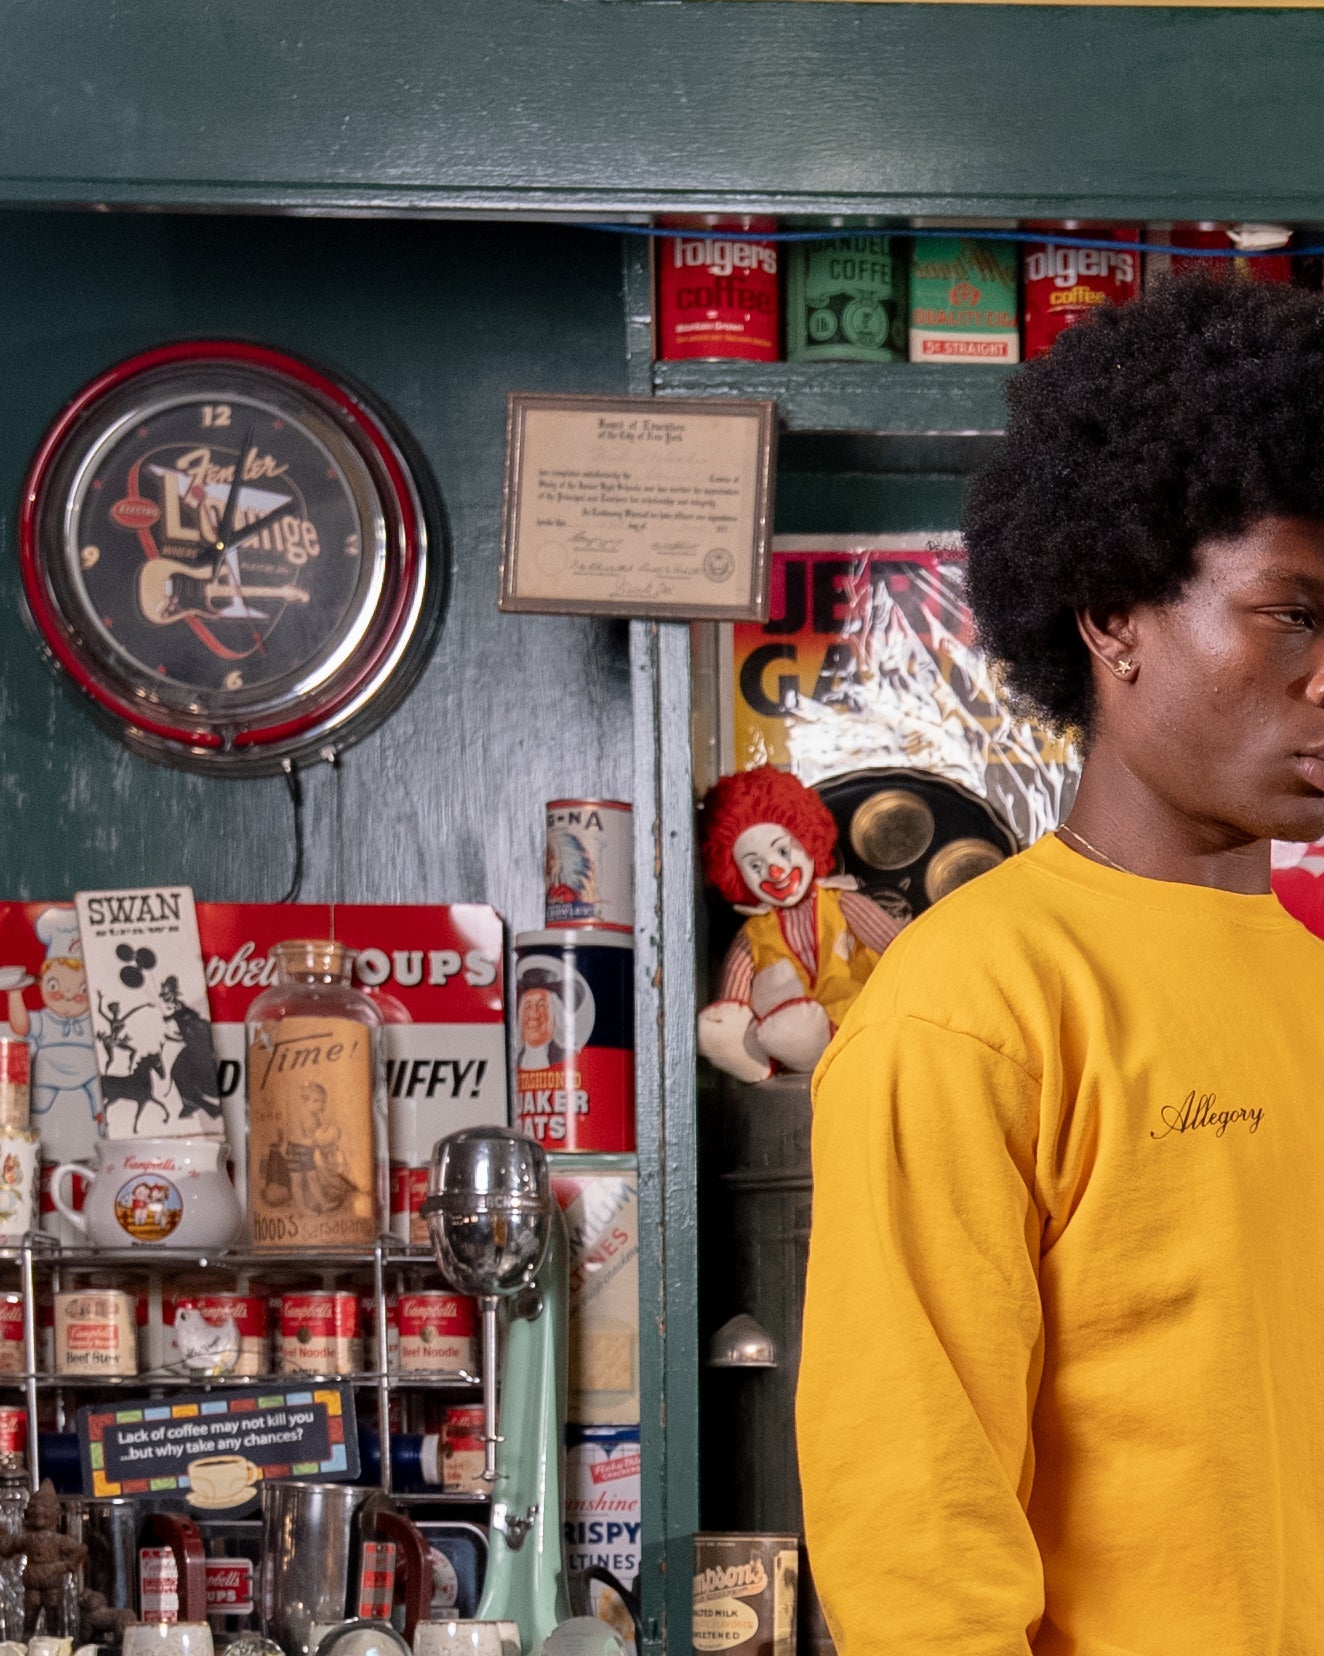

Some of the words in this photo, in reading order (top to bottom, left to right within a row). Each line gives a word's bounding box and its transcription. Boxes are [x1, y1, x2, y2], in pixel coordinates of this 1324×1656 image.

[1026, 245, 1134, 287] olgers
[913, 308, 982, 327] QUALITY
[202, 405, 232, 427] 12
[80, 545, 101, 570] 9
[224, 670, 243, 692] 6
[89, 892, 183, 927] SWAN
[355, 947, 499, 988] OUPS
[516, 1088, 589, 1115] UAKER
[1151, 1090, 1266, 1139] Allegory
[518, 1115, 567, 1141] ATS
[403, 1300, 458, 1320] Campbell's
[423, 1345, 461, 1358] Noodle
[118, 1430, 149, 1445] Lack
[151, 1426, 166, 1441] of
[168, 1422, 209, 1440] coffee
[211, 1421, 241, 1438] may
[241, 1416, 265, 1430] not
[267, 1413, 287, 1428] kill
[289, 1413, 315, 1428] you
[155, 1443, 184, 1459] why
[186, 1436, 216, 1453] take
[218, 1435, 242, 1452] any
[243, 1428, 304, 1448] chances?
[565, 1490, 639, 1512] nshine
[564, 1521, 641, 1545] RISPY
[569, 1553, 636, 1571] LTINES
[692, 1558, 766, 1592] mpson's
[206, 1590, 237, 1603] UPS
[714, 1608, 739, 1618] MILK
[693, 1631, 741, 1641] EETENED
